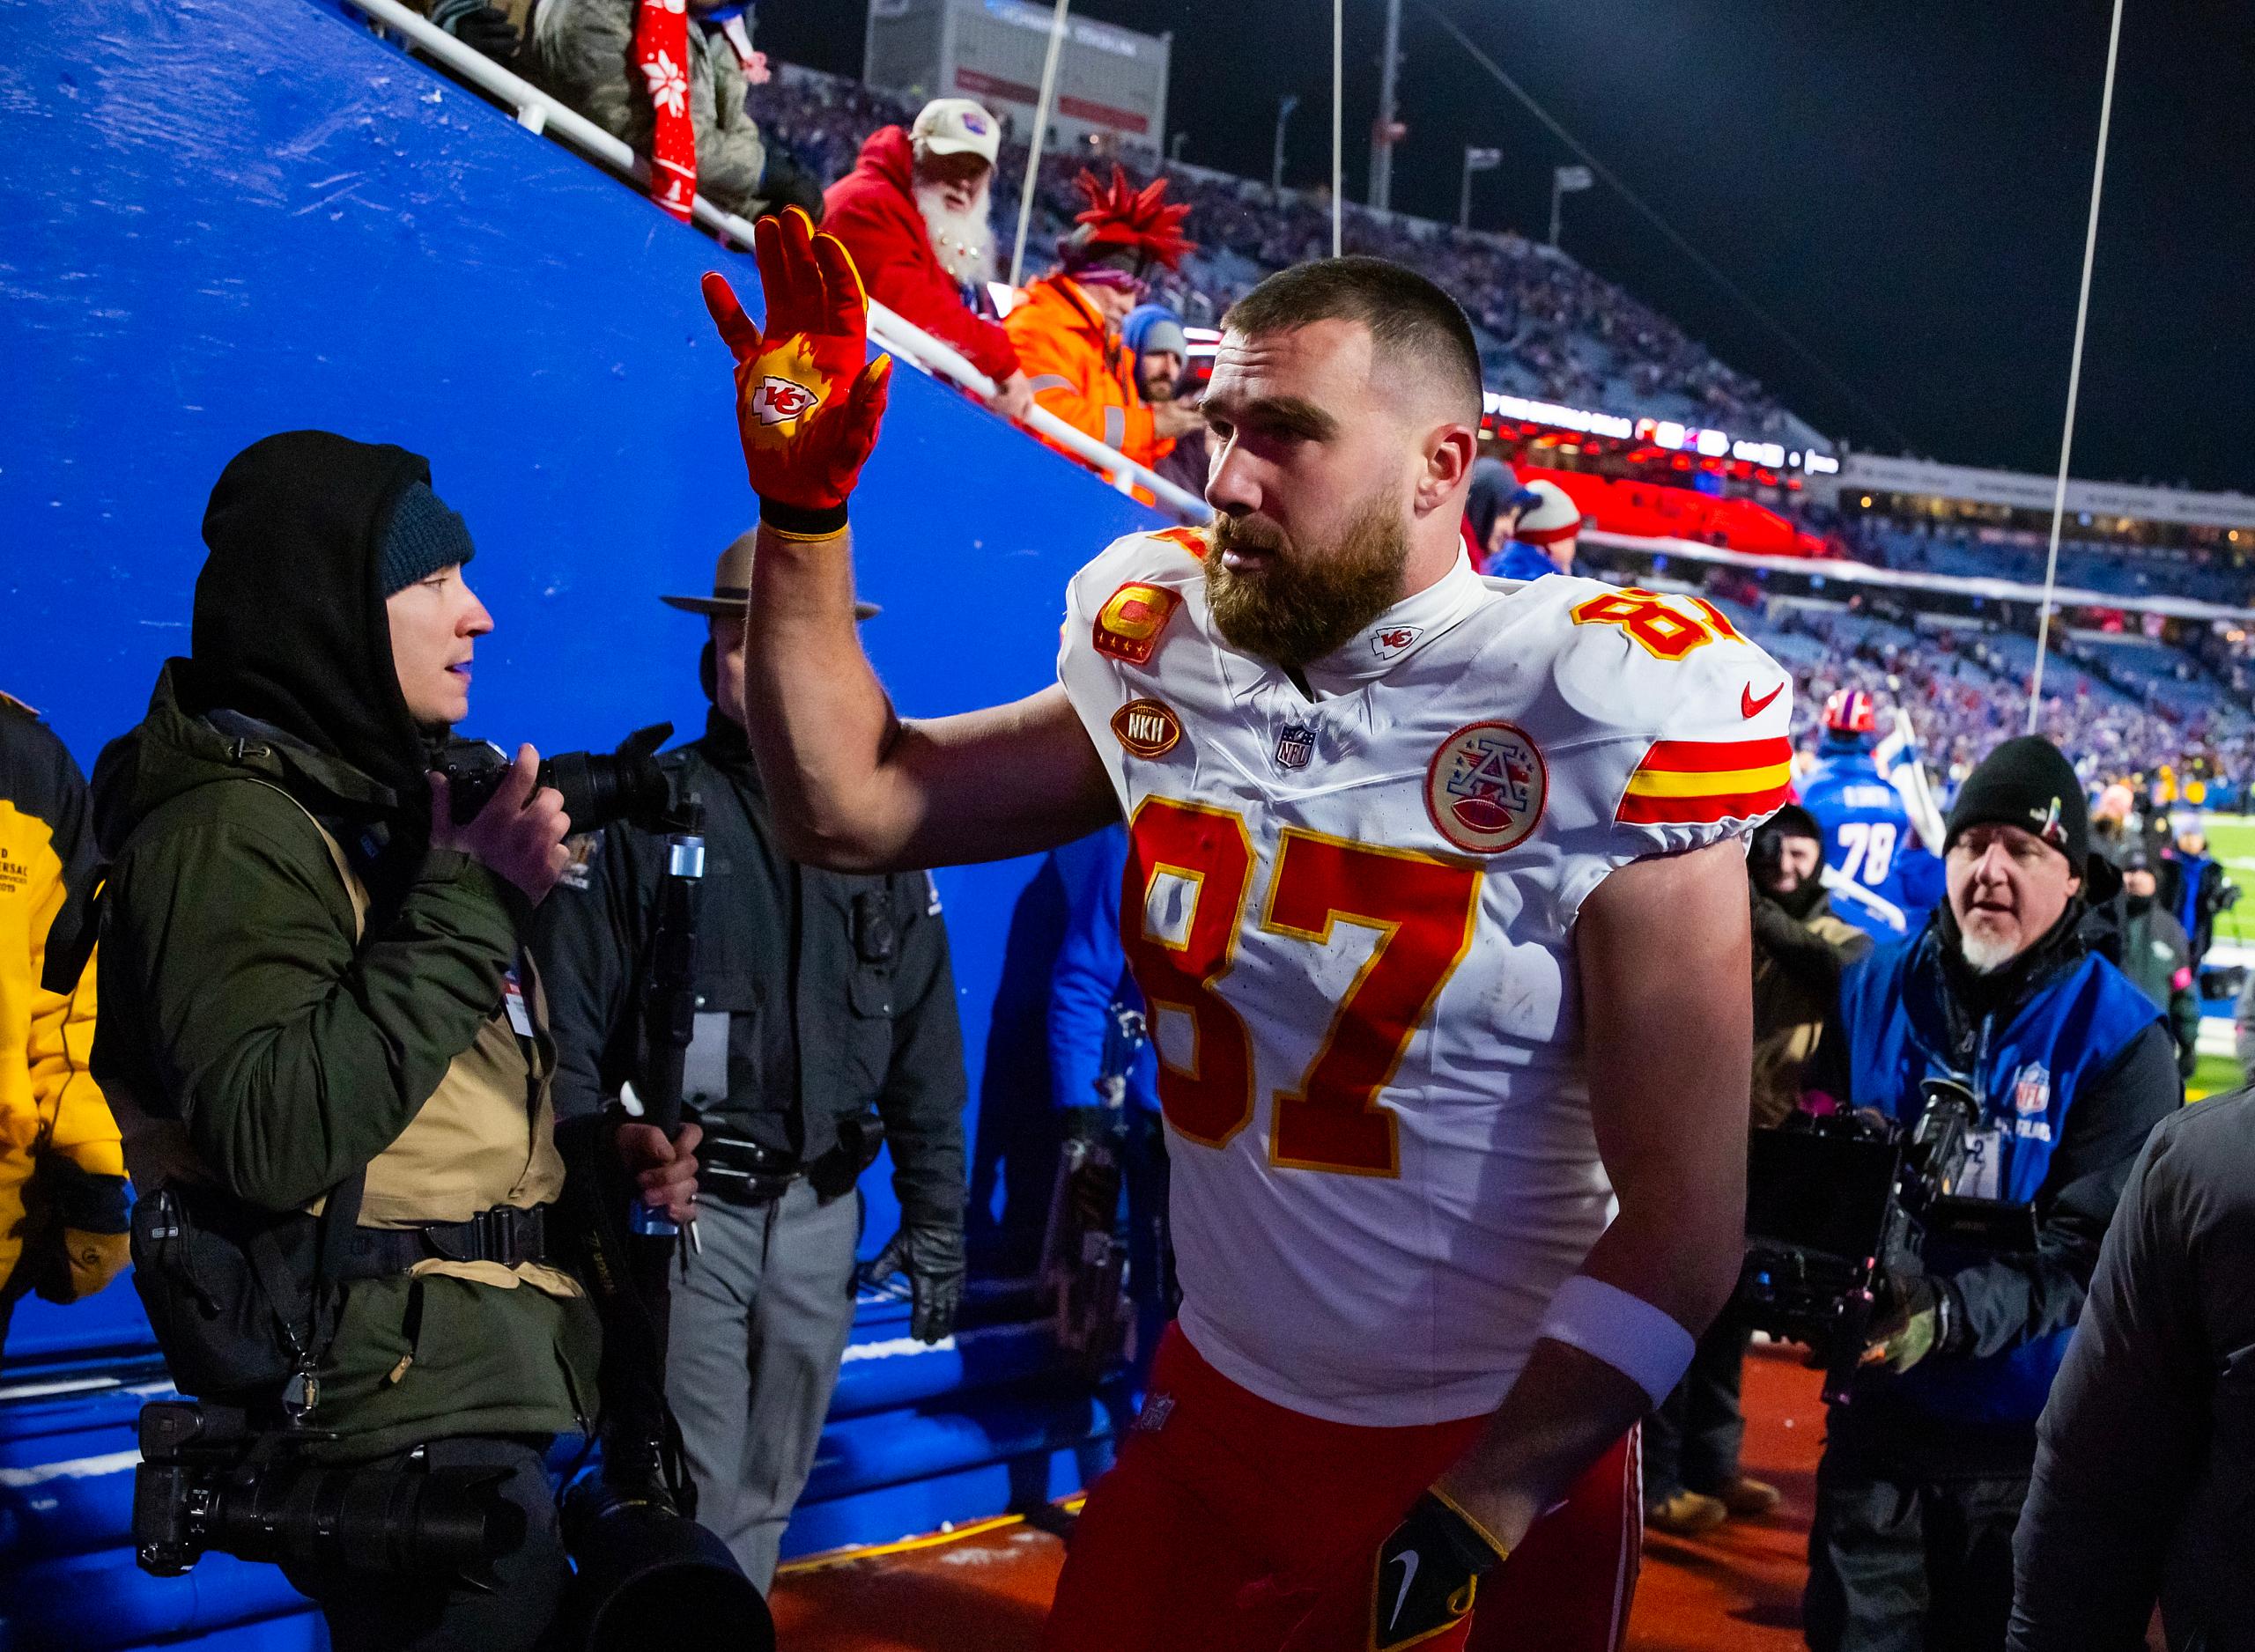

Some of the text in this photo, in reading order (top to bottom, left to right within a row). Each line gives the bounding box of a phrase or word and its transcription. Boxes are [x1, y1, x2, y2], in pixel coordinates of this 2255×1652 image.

[764, 386, 806, 415] KC
[1102, 586, 1169, 640] C
[1380, 630, 1414, 648] KC
[1128, 712, 1165, 743] NKH
[1447, 739, 1527, 812] A
[1837, 822, 1897, 886] 78
[1119, 794, 1487, 1178] 87
